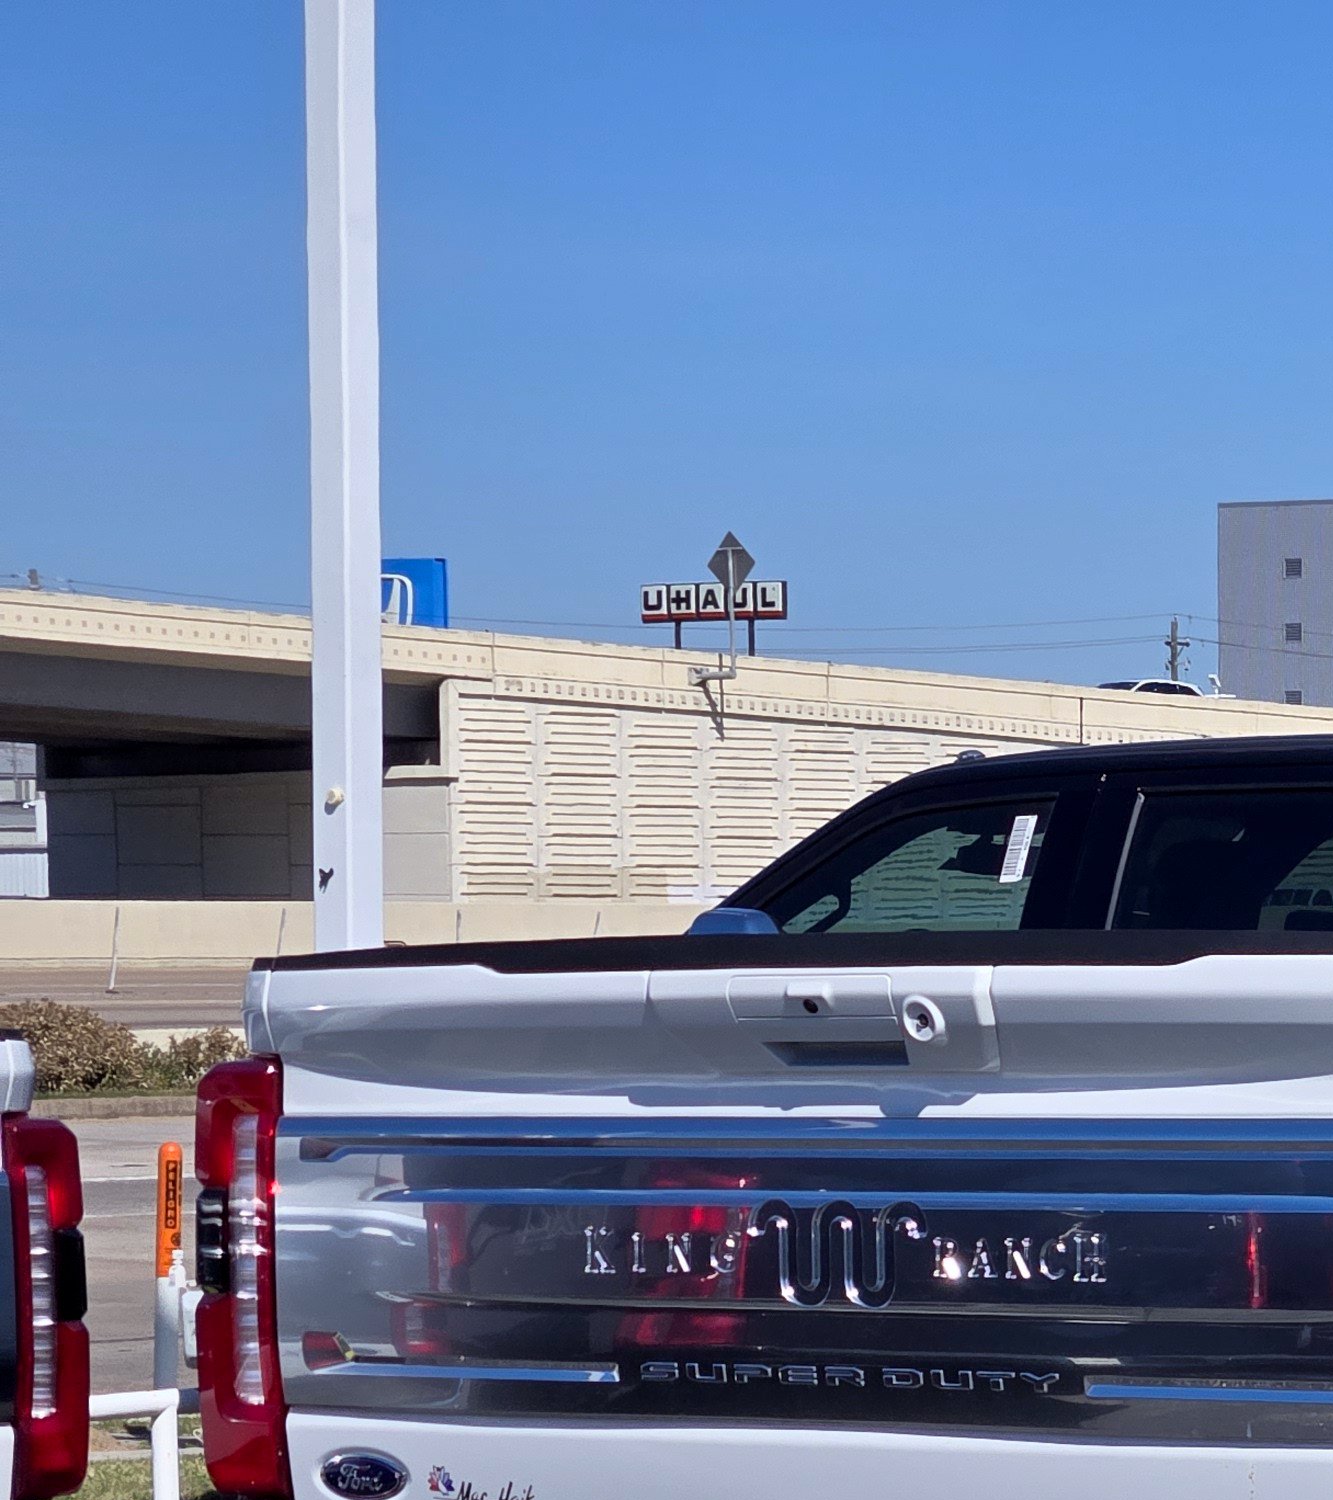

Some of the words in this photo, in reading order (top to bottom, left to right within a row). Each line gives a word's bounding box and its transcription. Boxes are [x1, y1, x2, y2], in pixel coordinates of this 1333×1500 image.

[166, 1161, 177, 1228] PELIGRO
[584, 1225, 741, 1275] KING
[932, 1232, 1107, 1283] RANCH
[640, 1362, 866, 1388] SUPER
[882, 1367, 1060, 1393] DUTY
[337, 1463, 385, 1493] Ford
